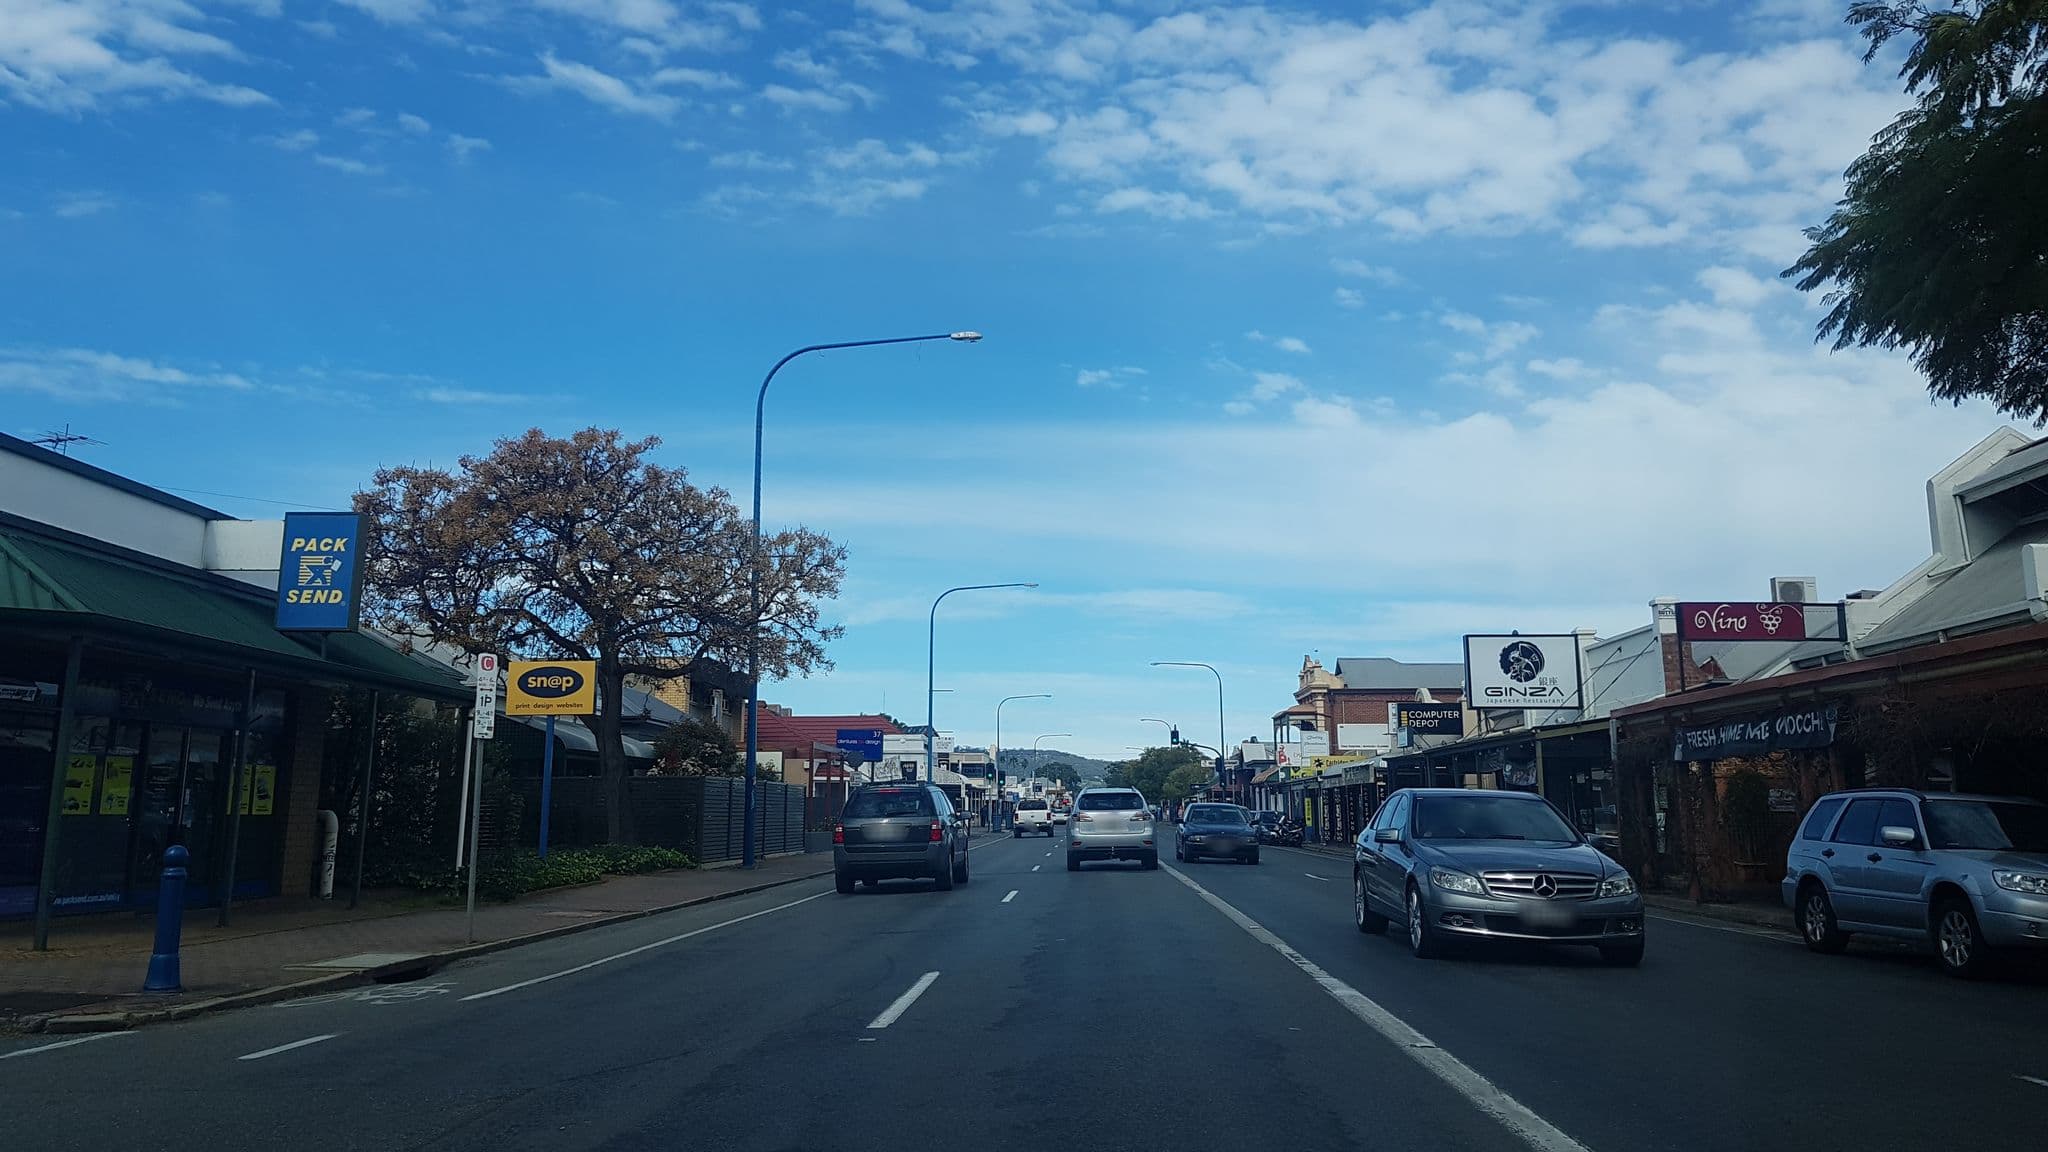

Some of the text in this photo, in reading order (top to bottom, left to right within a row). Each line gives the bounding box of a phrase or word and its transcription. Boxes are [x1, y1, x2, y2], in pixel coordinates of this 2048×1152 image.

[290, 537, 349, 552] PACK
[286, 589, 343, 604] SEND
[1694, 604, 1747, 632] Vino
[527, 675, 574, 691] sn@p
[1484, 687, 1564, 697] GINZA
[480, 695, 492, 707] 1P
[1409, 710, 1460, 719] COMPUTER
[1409, 719, 1439, 728] DEPOT
[1686, 727, 1716, 749] FRESH
